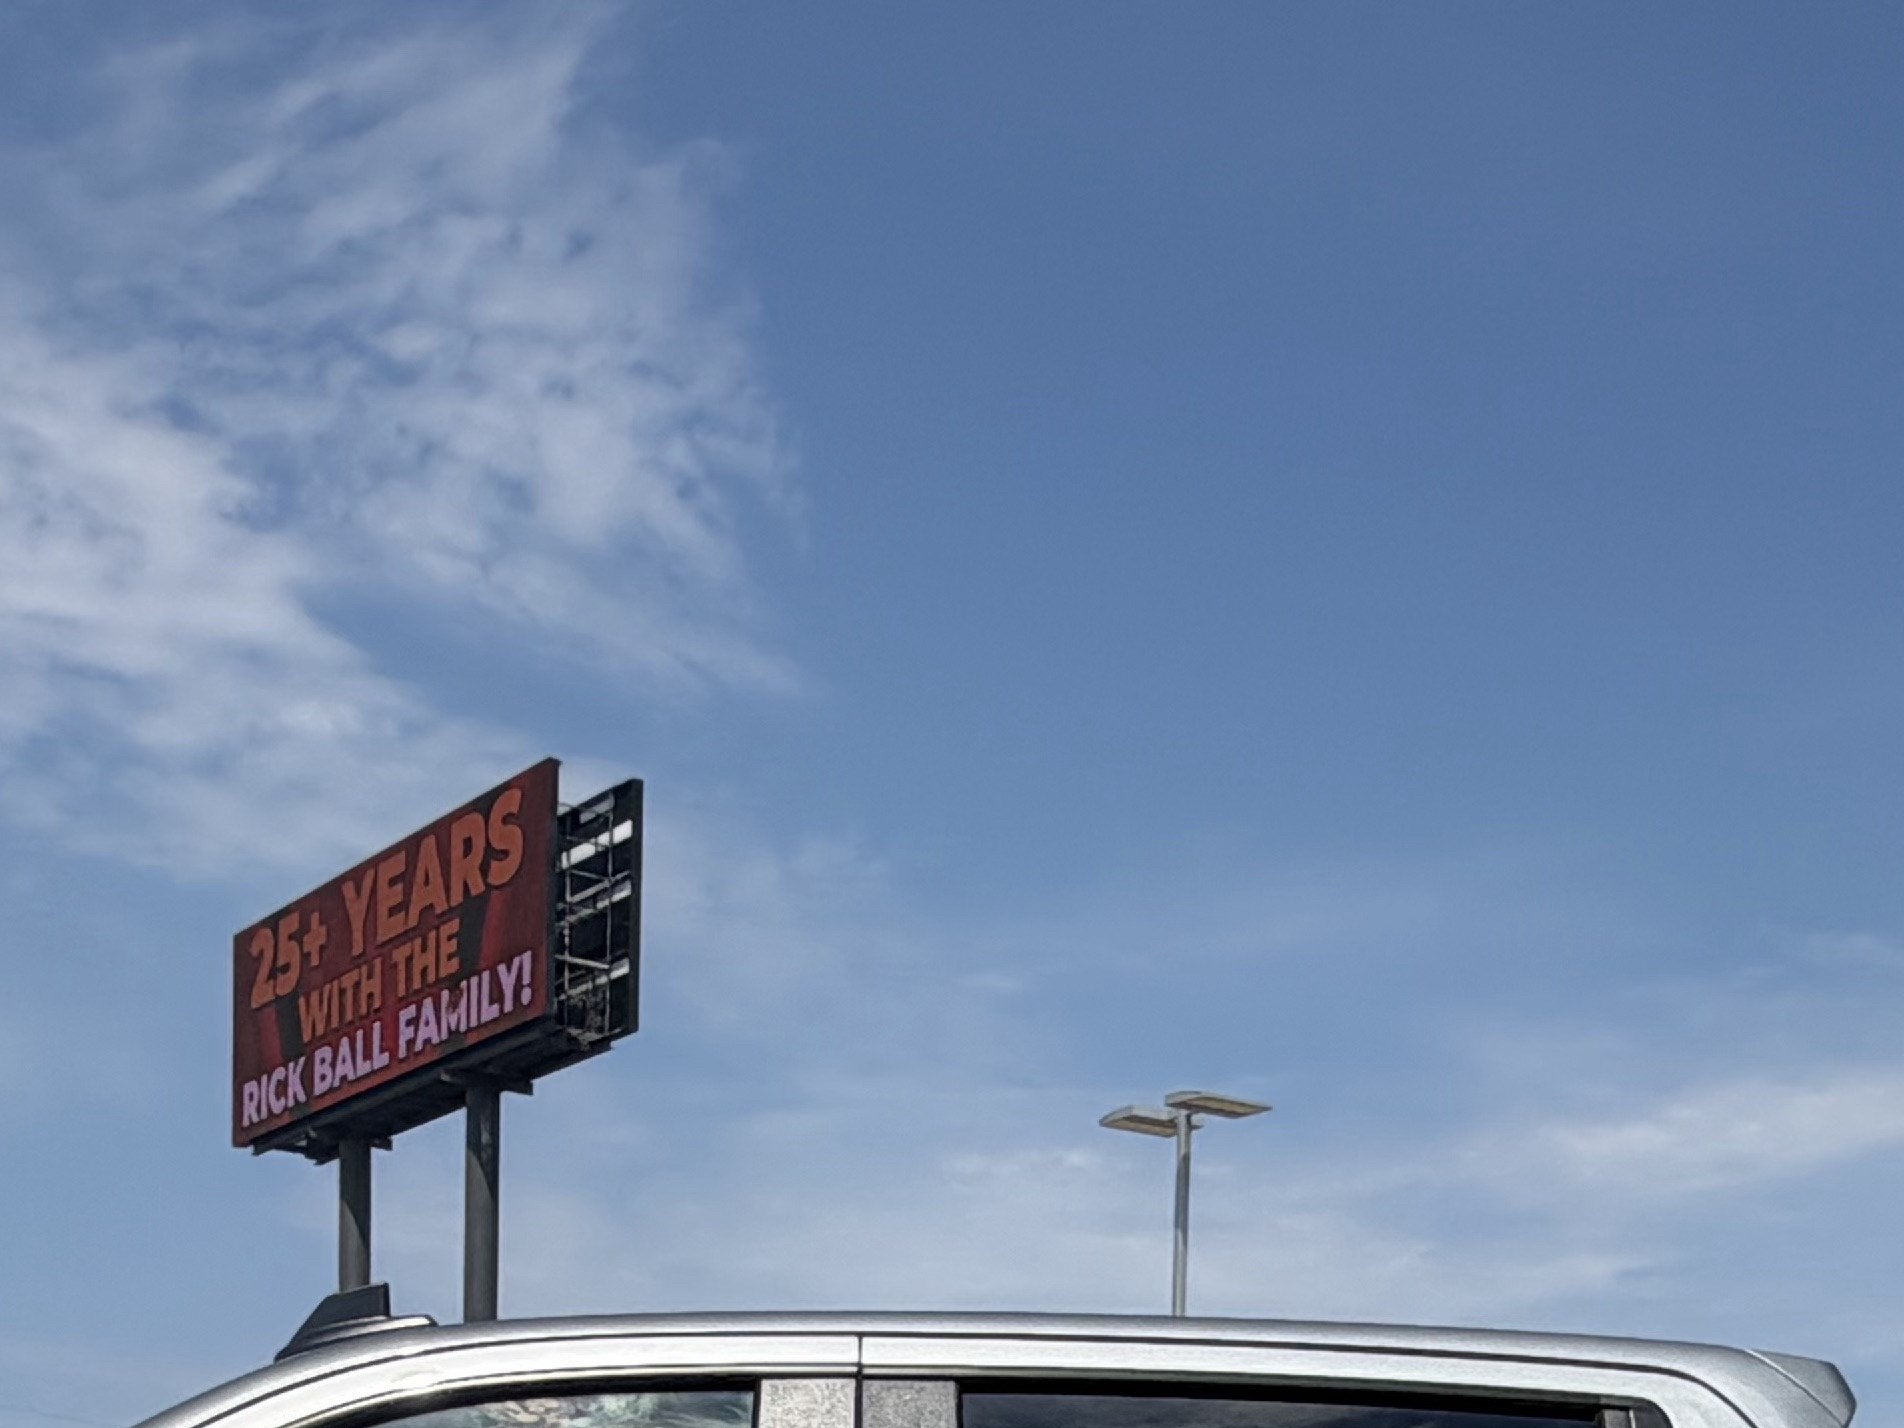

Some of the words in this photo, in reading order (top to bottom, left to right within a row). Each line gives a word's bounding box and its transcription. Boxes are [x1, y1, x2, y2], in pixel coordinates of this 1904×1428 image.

[249, 911, 328, 1009] 25+
[342, 788, 525, 957] YEARS
[299, 958, 382, 1043] WITH
[392, 918, 460, 998] THE
[242, 1056, 308, 1128] RICK
[312, 1021, 390, 1096] BALL
[398, 950, 533, 1060] FAMILY!
